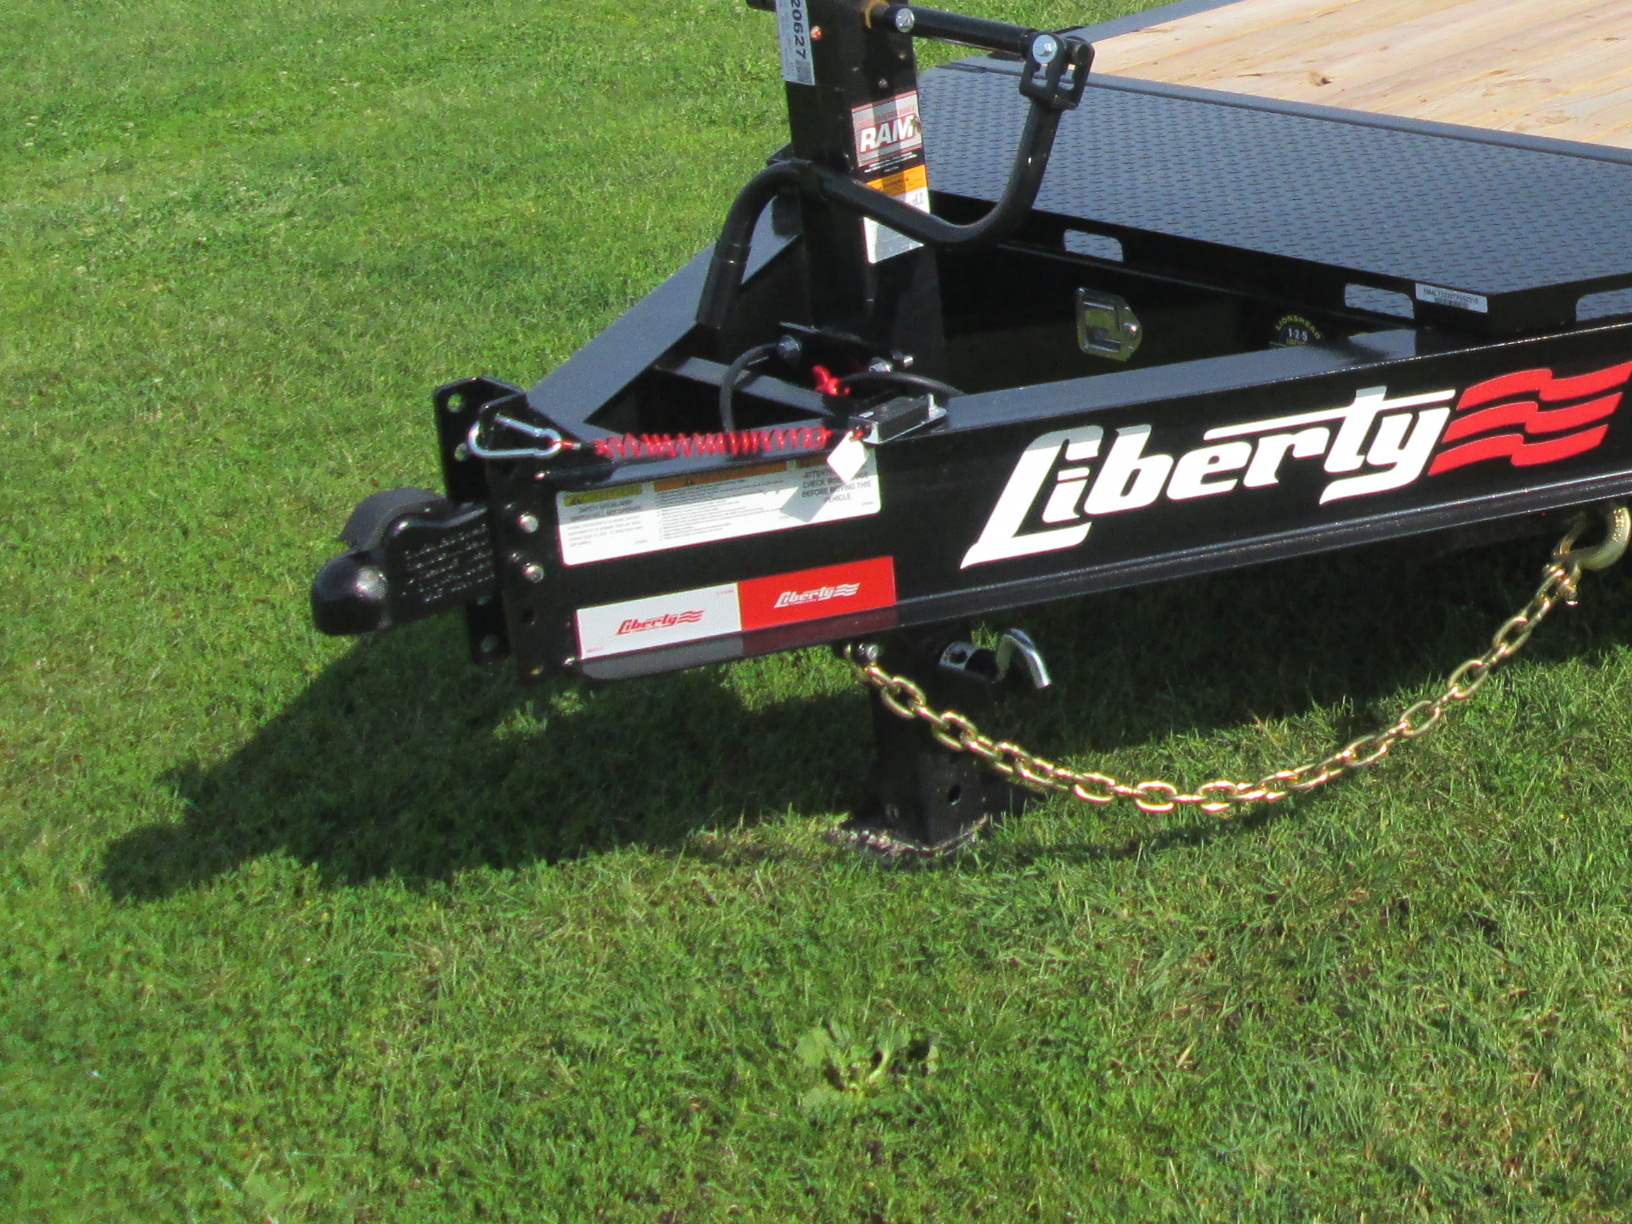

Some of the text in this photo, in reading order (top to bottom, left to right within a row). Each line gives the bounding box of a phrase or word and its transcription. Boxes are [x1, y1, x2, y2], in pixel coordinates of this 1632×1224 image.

[860, 114, 916, 153] RAM
[959, 384, 1457, 571] Liberty
[774, 585, 835, 610] Liberty
[615, 611, 679, 637] Liberty
